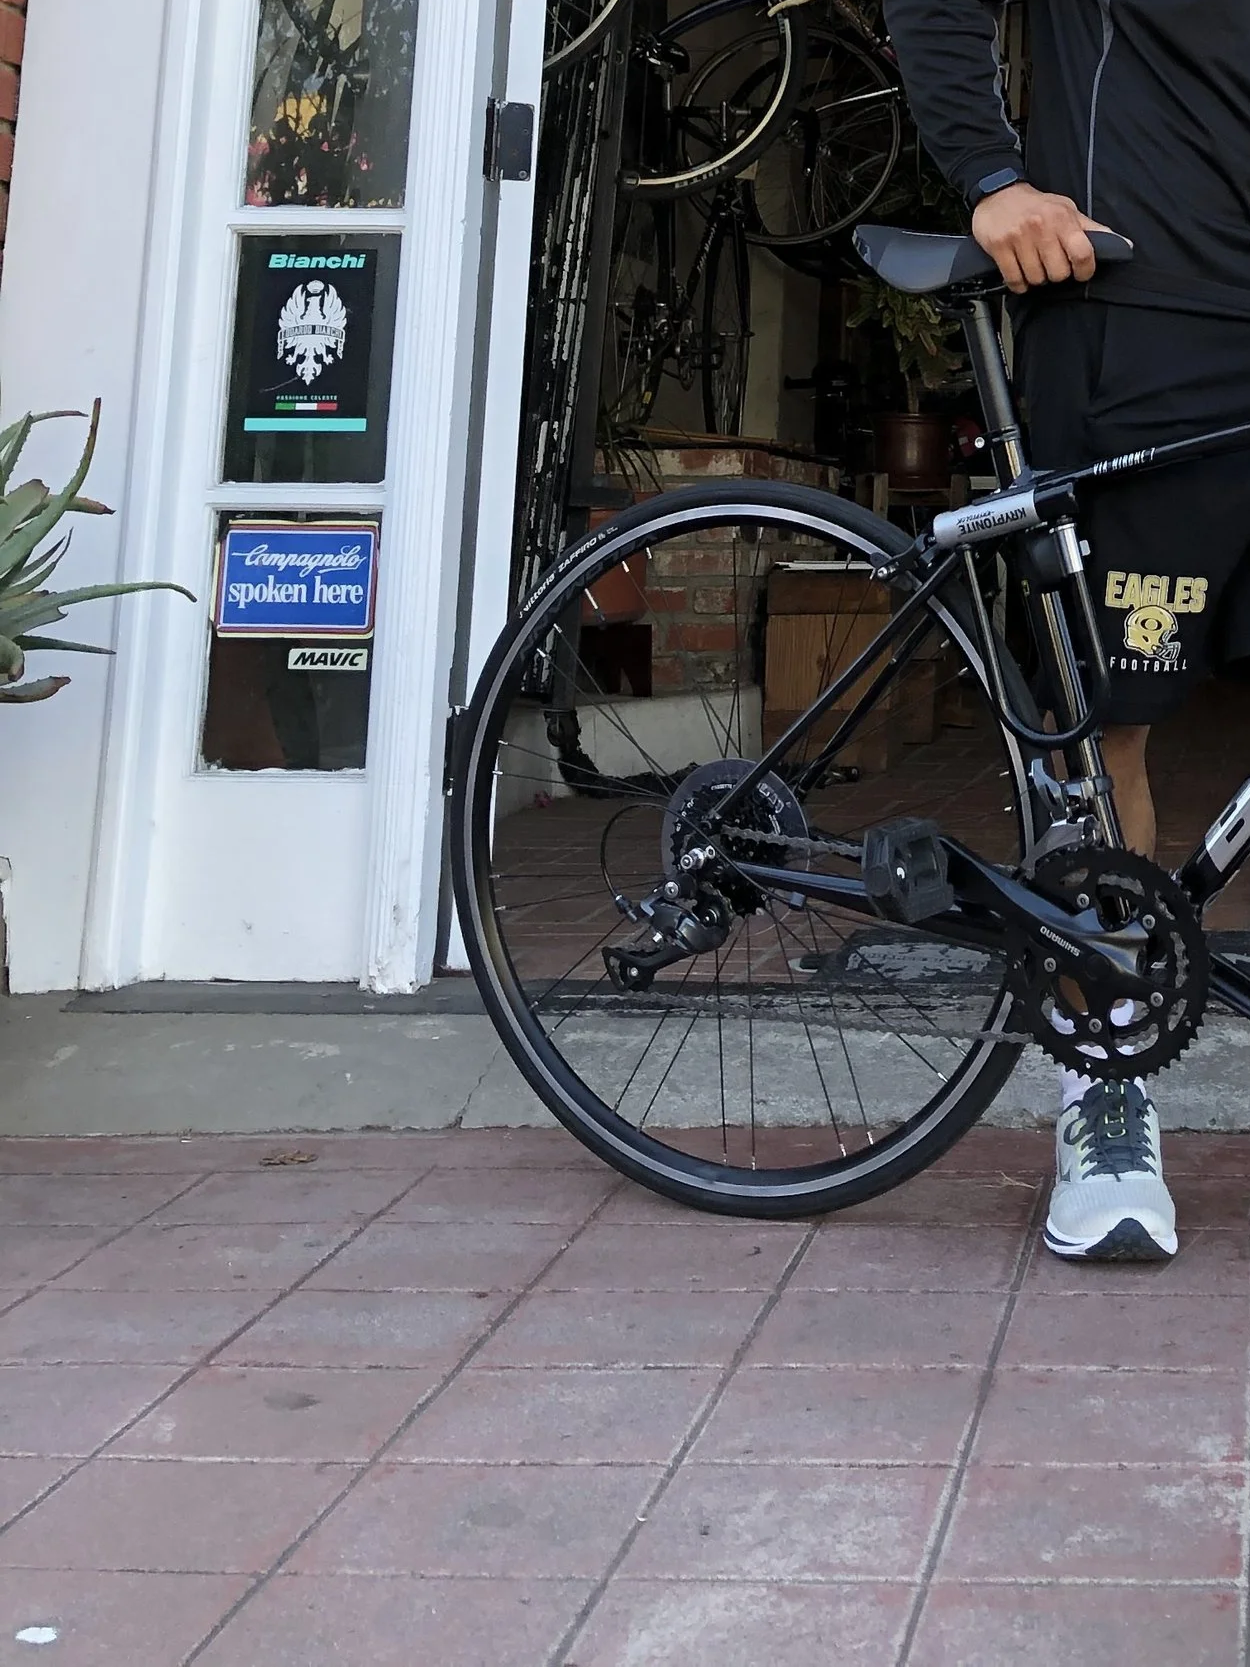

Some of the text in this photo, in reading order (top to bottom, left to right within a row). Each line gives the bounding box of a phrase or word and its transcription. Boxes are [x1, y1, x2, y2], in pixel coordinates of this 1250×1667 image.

[268, 253, 366, 269] Bianchi
[1093, 460, 1108, 475] VIA
[1150, 447, 1156, 461] 7
[958, 507, 1027, 535] KRYPTONITE
[231, 544, 367, 578] Campagnolo
[228, 575, 364, 609] spoken here
[1104, 570, 1209, 613] EAGLES
[292, 651, 364, 667] MAVIC
[1110, 656, 1188, 672] FOOTBALL
[1040, 925, 1081, 957] SHIMANO
